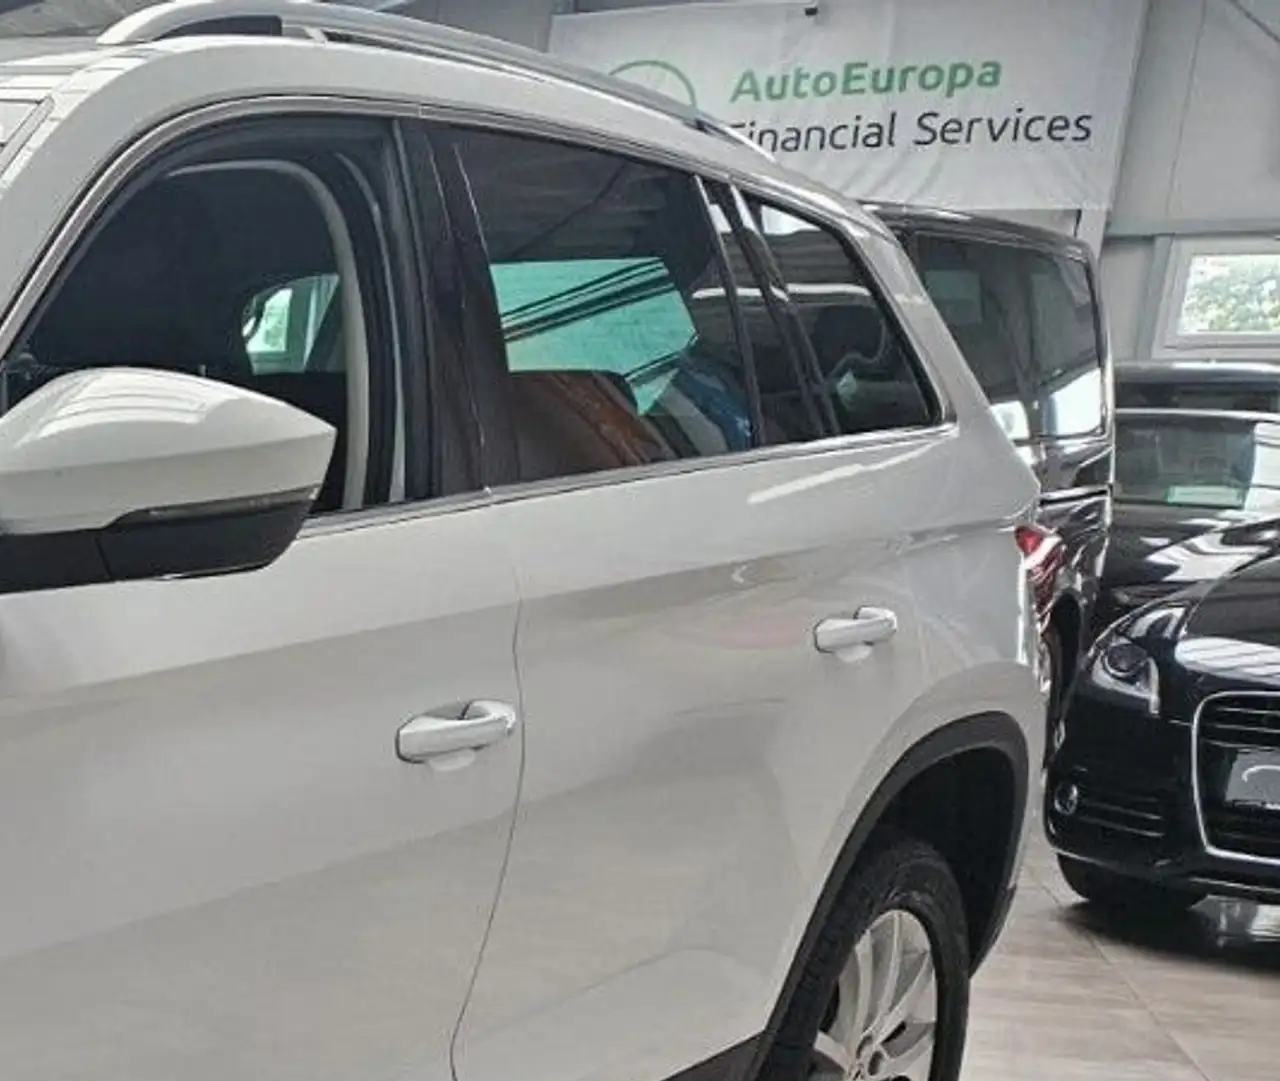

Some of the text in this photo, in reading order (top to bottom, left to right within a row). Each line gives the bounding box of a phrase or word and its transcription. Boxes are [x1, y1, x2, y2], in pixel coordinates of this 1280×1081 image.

[730, 60, 1002, 103] AutoEuropa
[730, 107, 1092, 153] inancial Services
